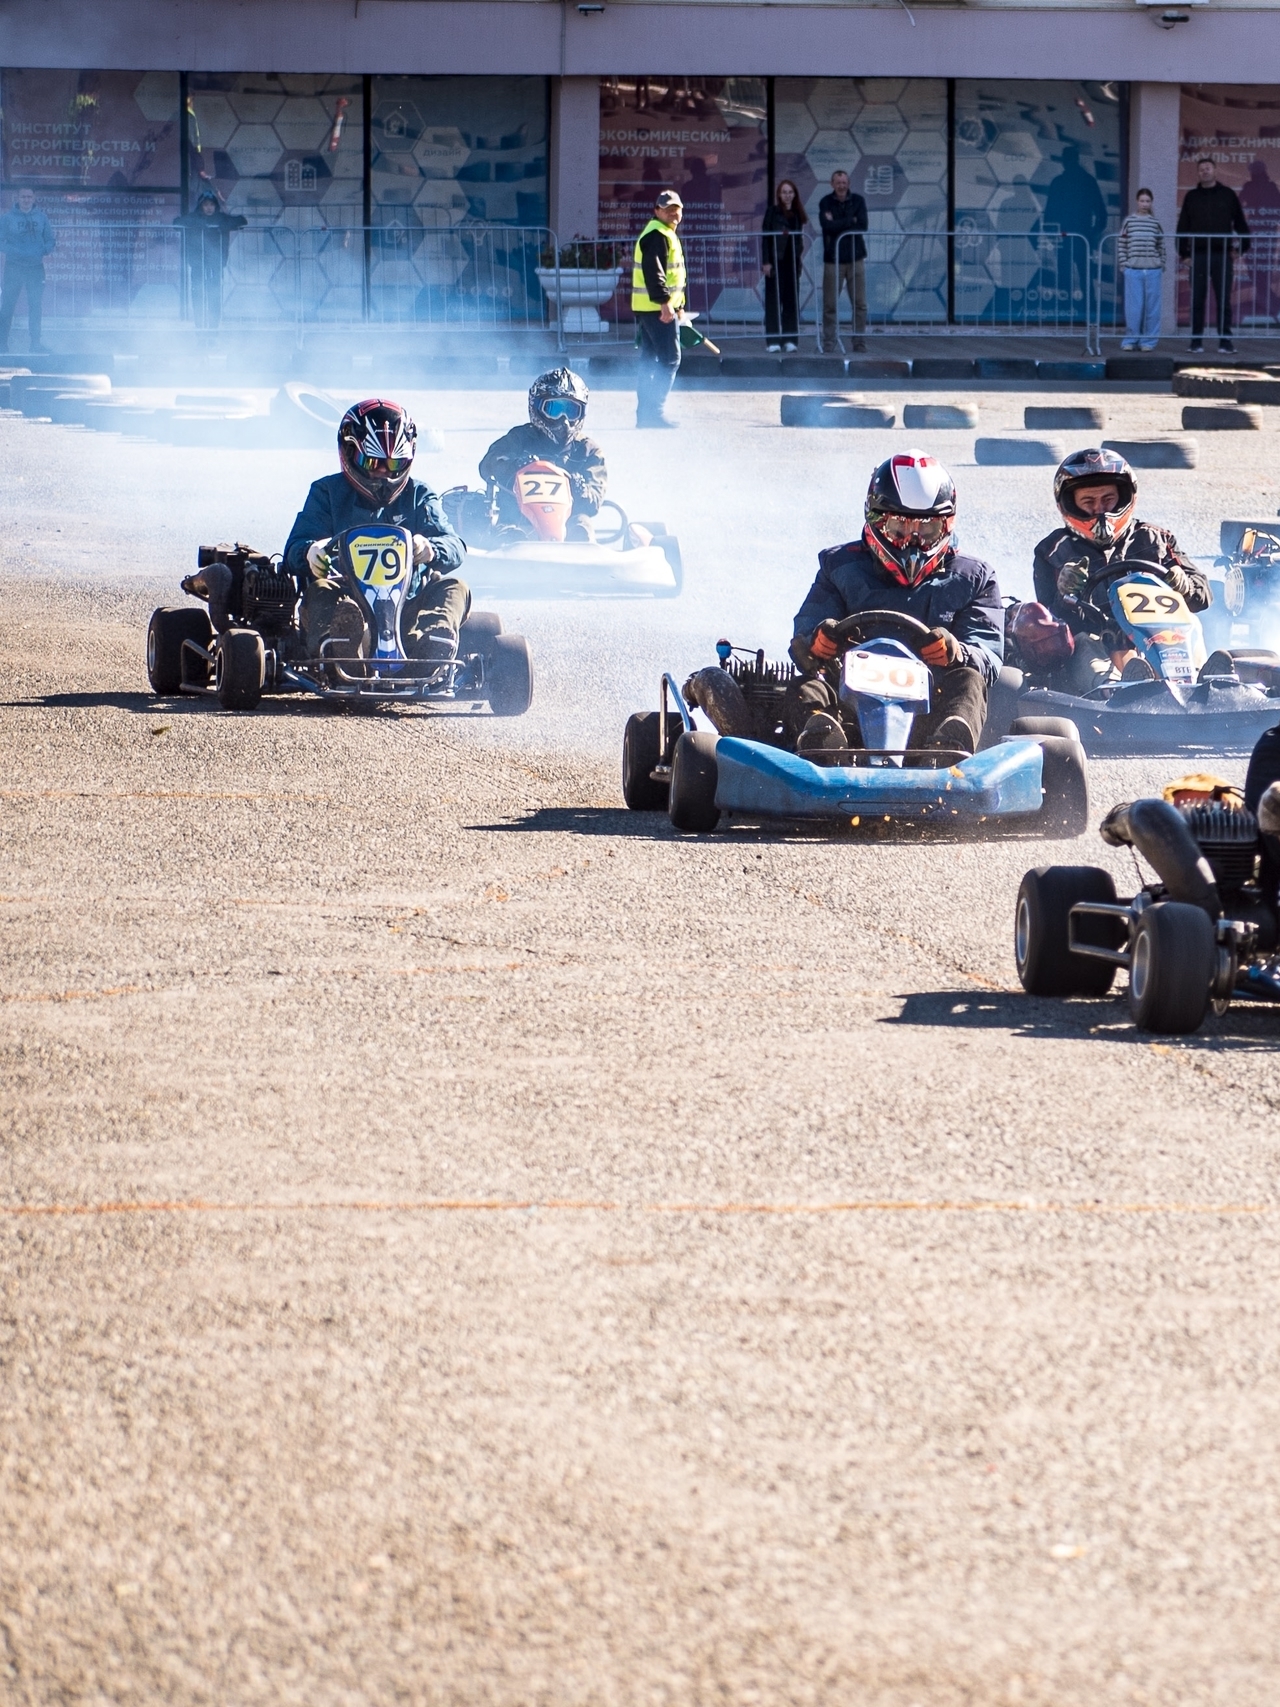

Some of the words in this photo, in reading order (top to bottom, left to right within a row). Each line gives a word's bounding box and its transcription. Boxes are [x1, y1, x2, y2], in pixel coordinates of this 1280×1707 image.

[11, 122, 91, 135] ИНСТИТУТ
[599, 129, 731, 143] ЭКОНОМИЧЕСКИЙ
[11, 139, 141, 152] СТРОИТЕЛЬСТВА
[145, 140, 156, 152] И
[423, 147, 462, 157] дизайн
[599, 146, 686, 157] ФАКУЛЬТЕТ
[11, 155, 125, 167] АРХИТЕКТУРЫ
[1179, 152, 1256, 163] АКУЛЬТЕТ
[523, 480, 563, 497] 27
[358, 548, 401, 581] 79
[1126, 592, 1180, 614] 29
